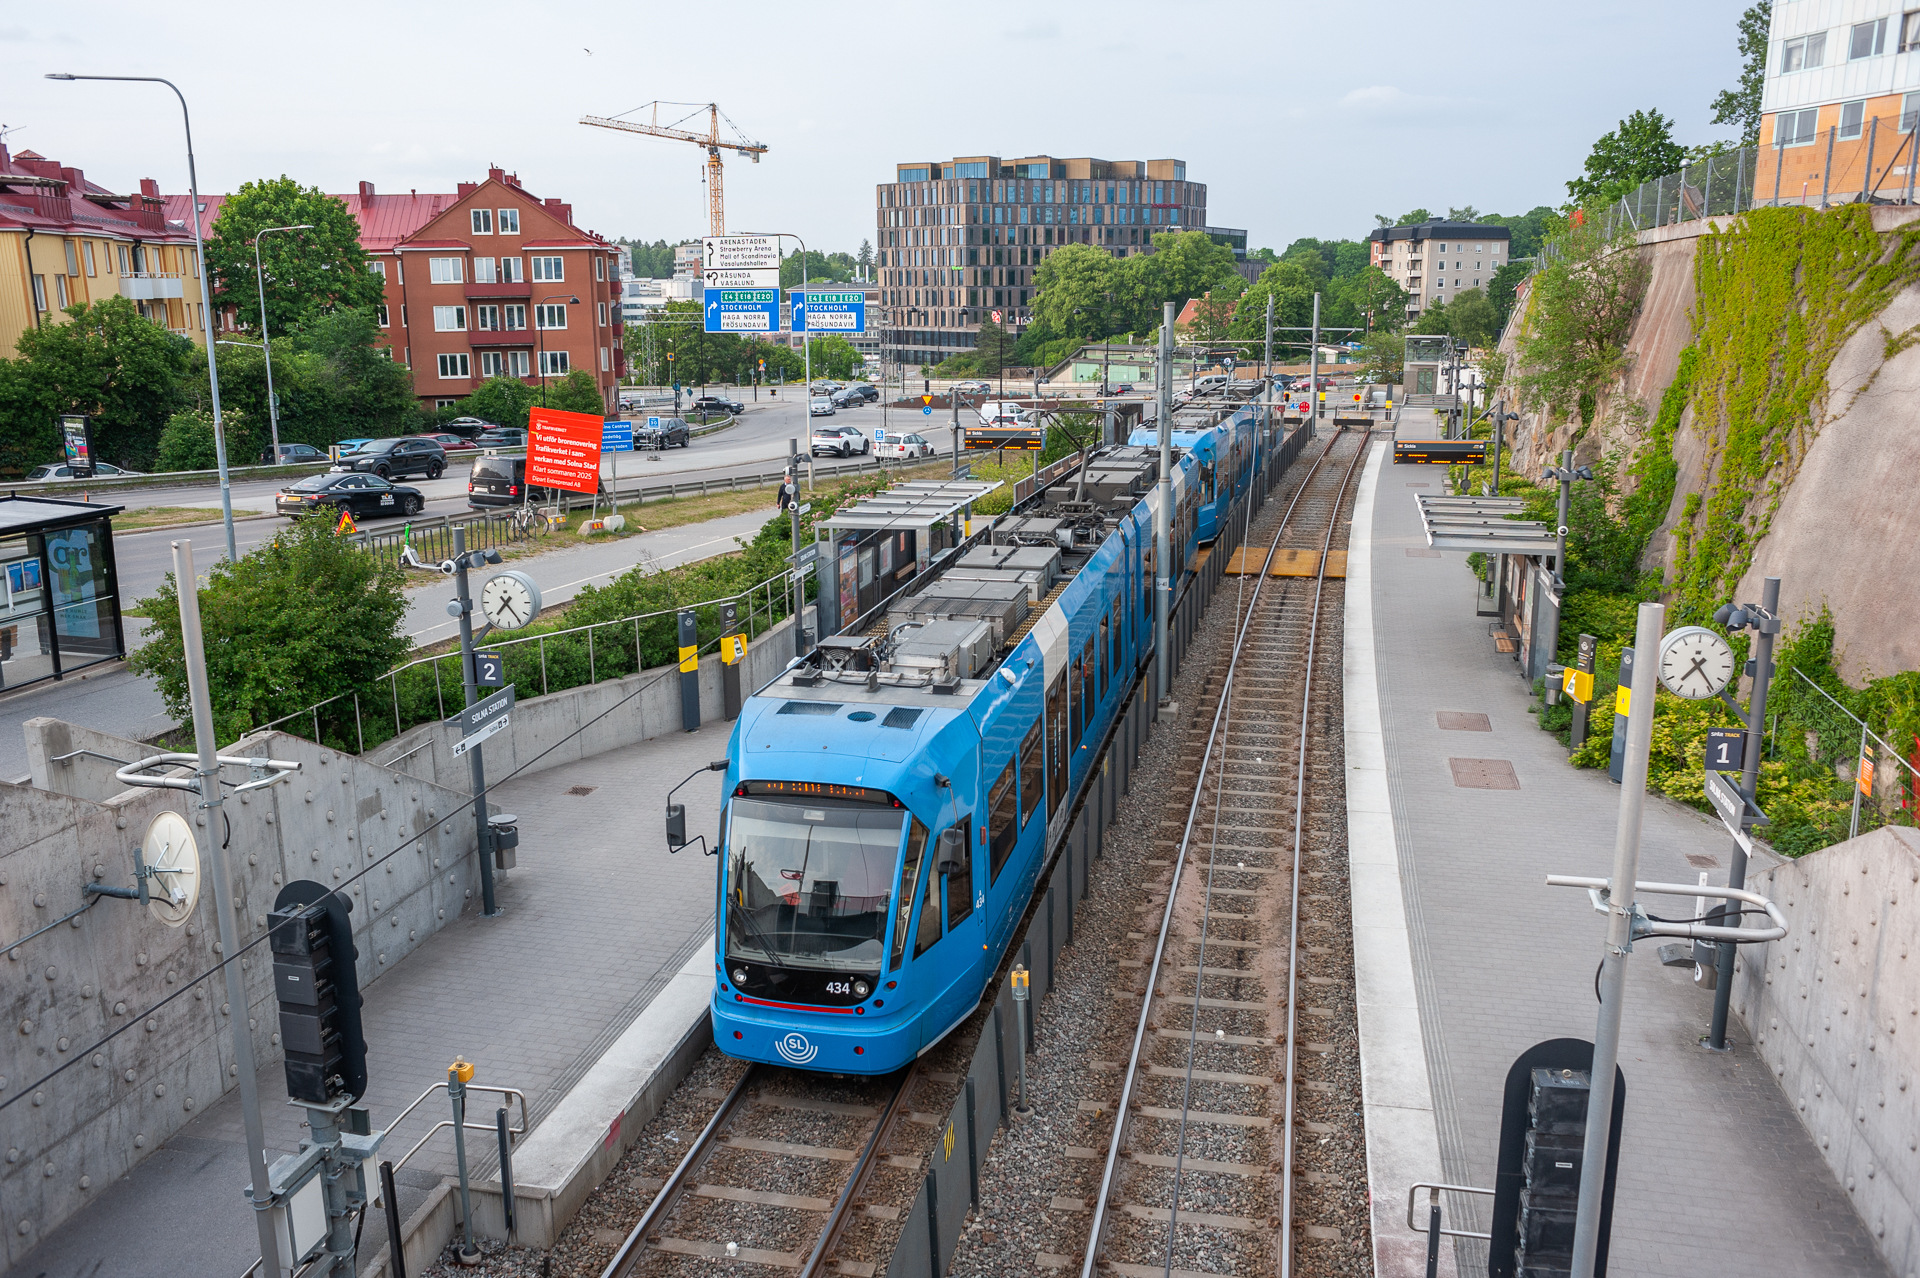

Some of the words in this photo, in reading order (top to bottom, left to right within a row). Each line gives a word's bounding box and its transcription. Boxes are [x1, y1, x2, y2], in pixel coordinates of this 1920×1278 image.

[535, 444, 567, 455] Trafikverket
[558, 437, 597, 450] brorenovering
[567, 459, 582, 468] Solna
[547, 468, 576, 477] sommaren
[547, 478, 573, 486] Entreprenad
[484, 663, 496, 680] 2
[472, 708, 488, 724] SOLNA
[488, 696, 508, 714] STATION
[1716, 743, 1729, 764] 1
[1709, 780, 1721, 800] SOLNA
[1720, 792, 1736, 816] STATION
[976, 894, 985, 909] 434
[826, 982, 850, 994] 434
[788, 1038, 804, 1050] SL
